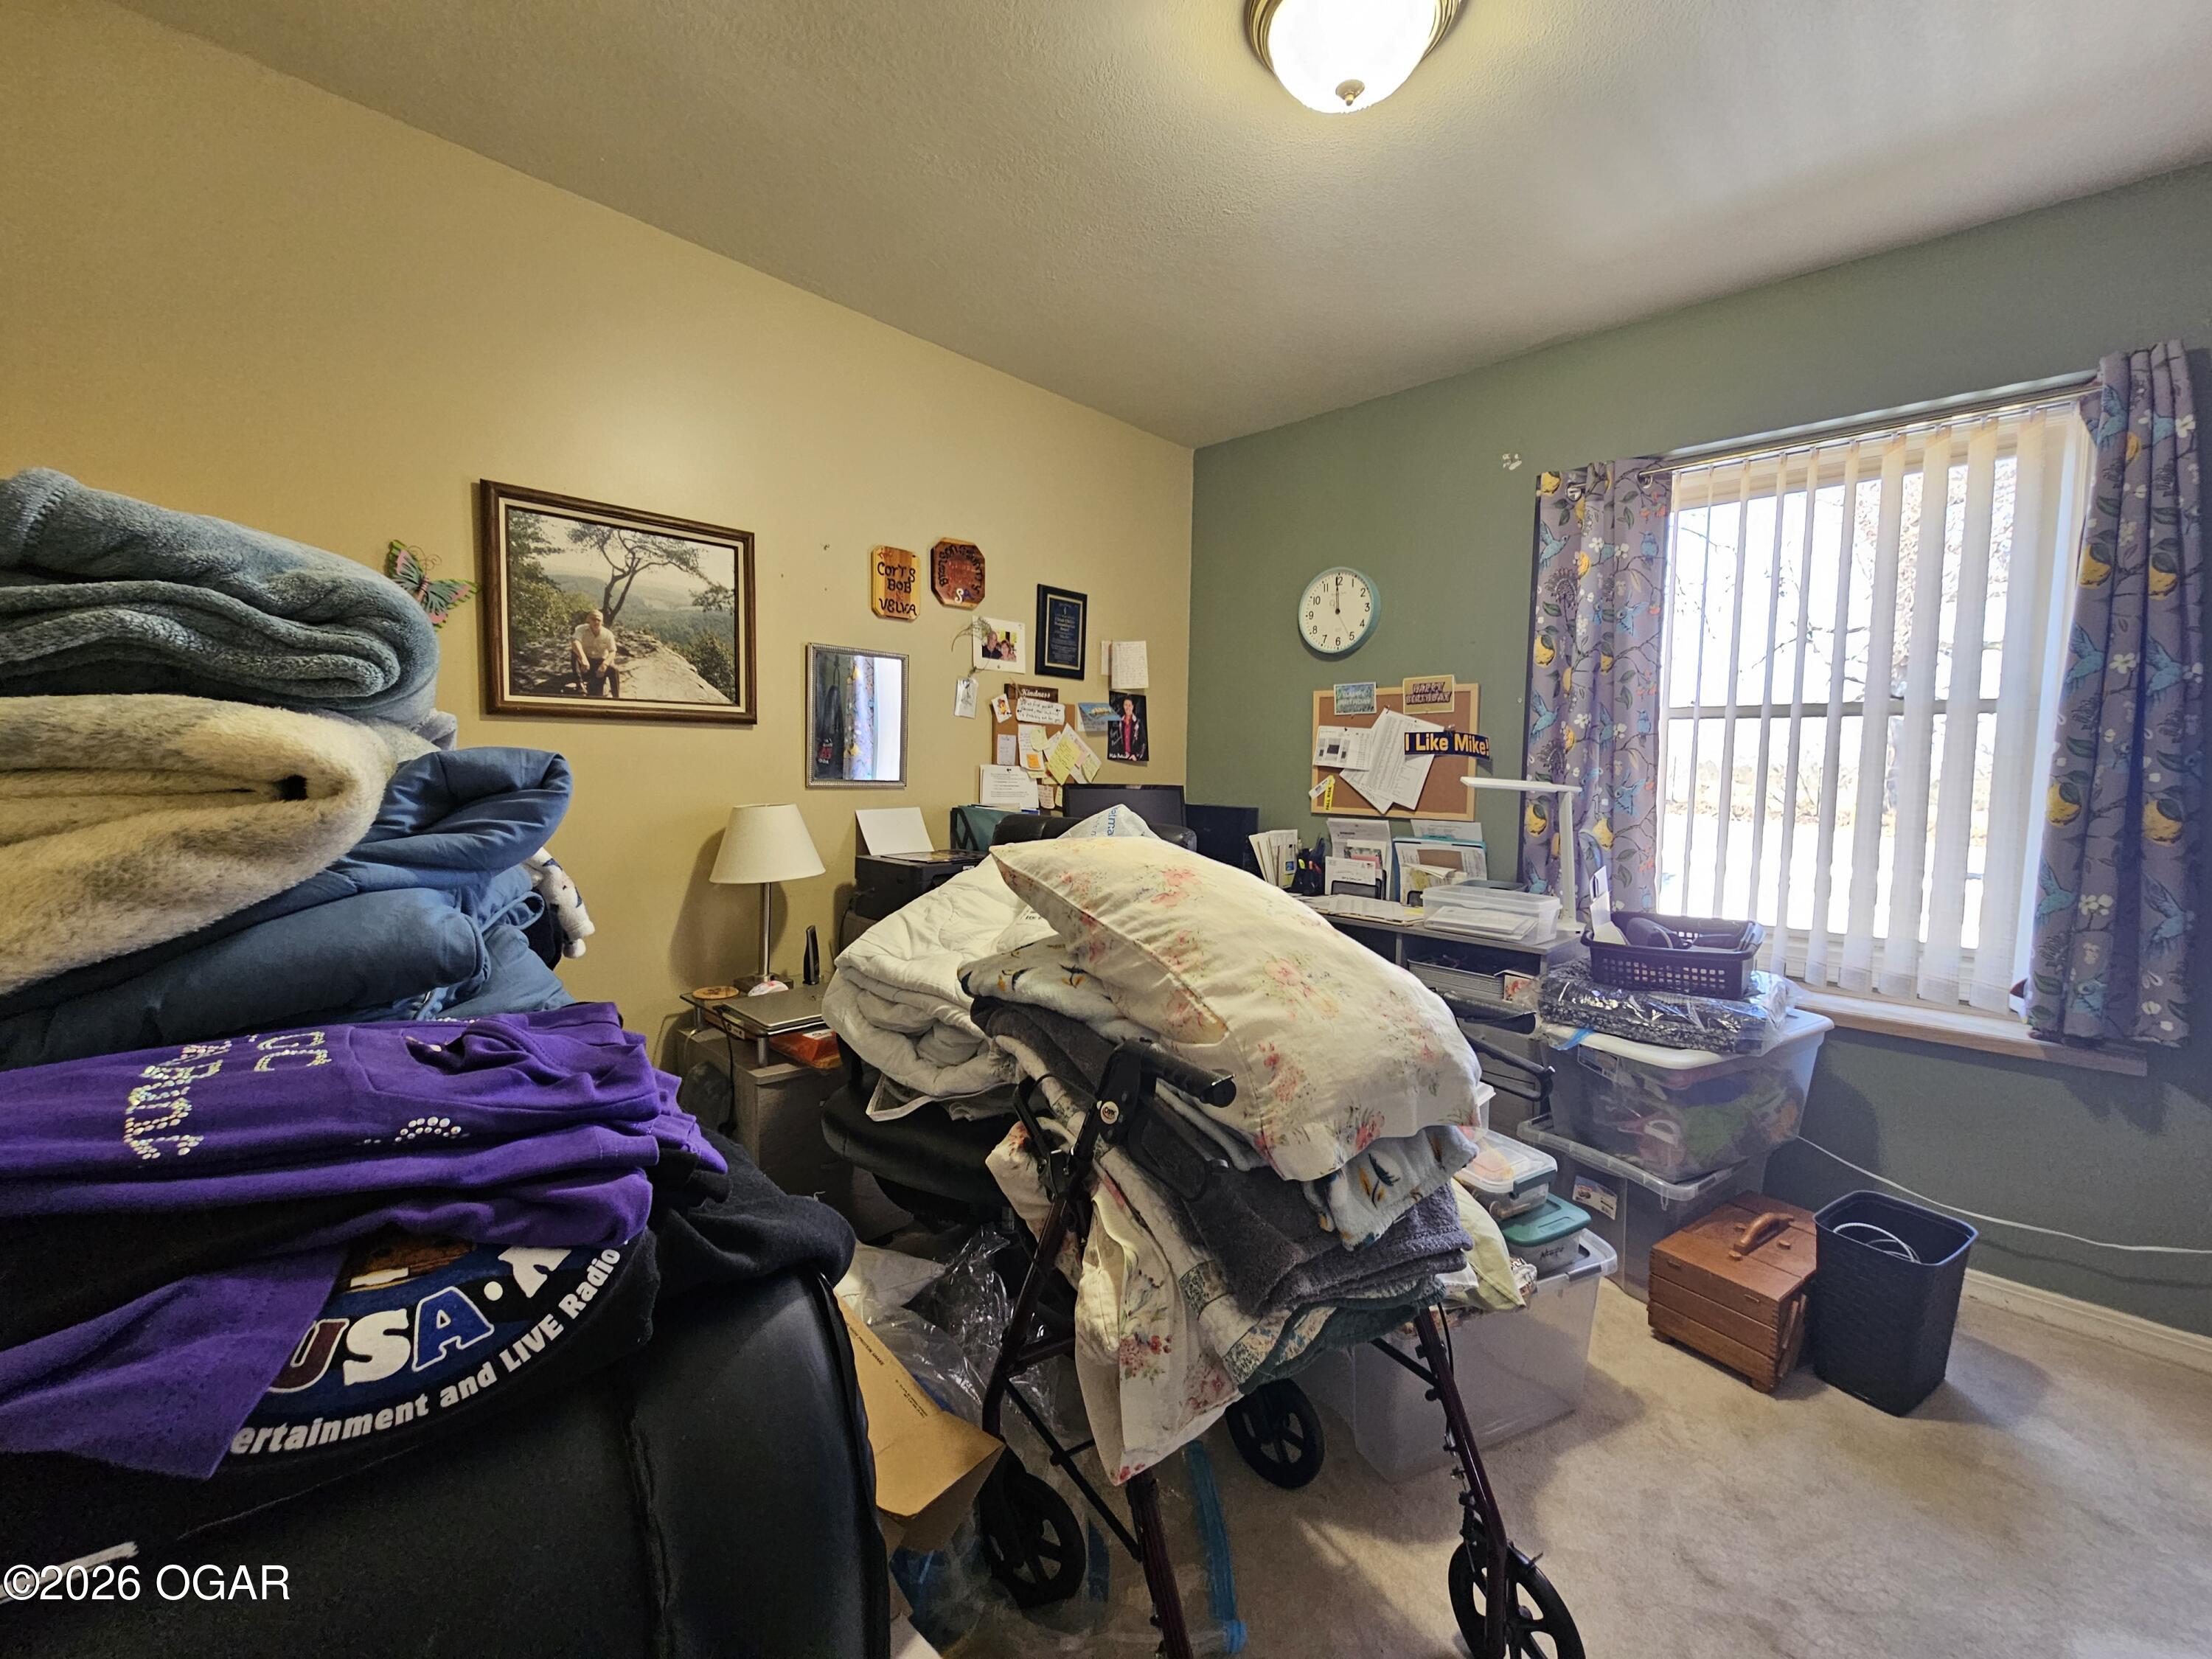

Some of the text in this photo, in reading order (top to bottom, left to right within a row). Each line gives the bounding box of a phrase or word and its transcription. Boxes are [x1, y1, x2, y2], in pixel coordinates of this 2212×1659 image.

[1324, 582, 1329, 593] 11
[1352, 578, 1354, 588] 1
[1360, 588, 1366, 598] 2
[1312, 596, 1321, 605] 10
[1364, 602, 1370, 612] 3
[1308, 611, 1314, 620] 9
[1359, 619, 1365, 628] 4
[1312, 625, 1318, 634] 8
[1322, 634, 1327, 644] 7
[1335, 636, 1341, 646] 6
[1349, 631, 1354, 641] 5
[1021, 689, 1051, 698] Kindness
[1405, 733, 1489, 757] I Like Mike!
[268, 1285, 495, 1393] USA
[229, 1394, 429, 1455] ertainment
[440, 1364, 498, 1408] and
[499, 1313, 565, 1373] LIVE
[558, 1248, 621, 1320] Radio
